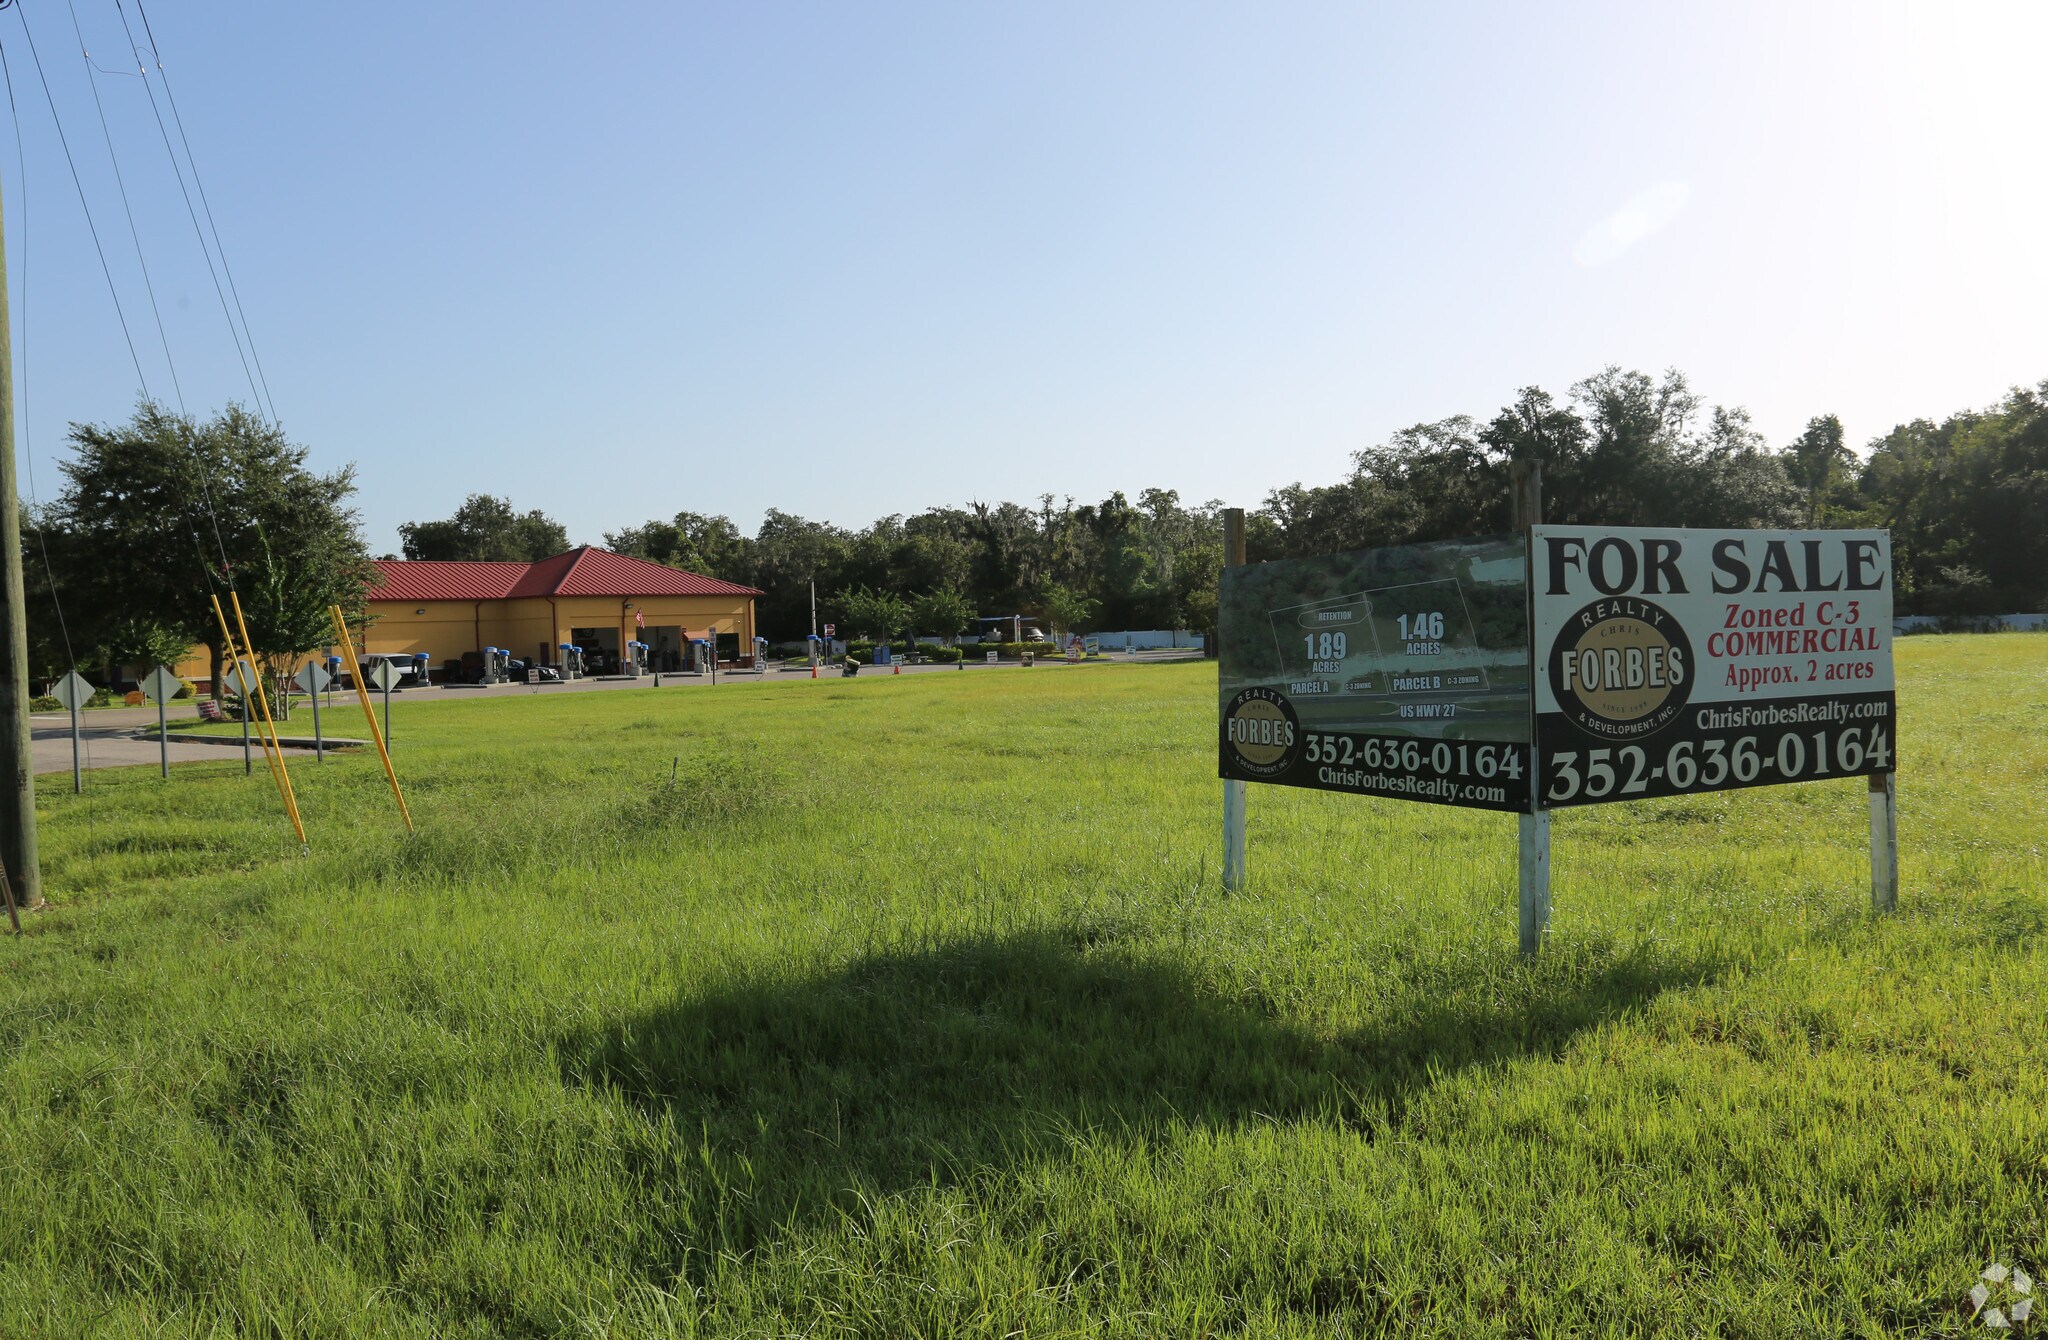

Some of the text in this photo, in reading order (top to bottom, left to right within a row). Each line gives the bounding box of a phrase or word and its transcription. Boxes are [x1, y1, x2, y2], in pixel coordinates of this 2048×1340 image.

[1543, 536, 1885, 596] FOR SALE
[1318, 611, 1352, 621] RETENTION
[1397, 611, 1444, 640] 1.46
[1581, 600, 1664, 628] REALTY
[1723, 600, 1860, 629] Zoned C-3
[1304, 632, 1347, 660] 1.89
[1600, 625, 1640, 638] CHRIS
[1707, 627, 1881, 658] COMMERCIAL
[1406, 642, 1441, 655] ACRES
[1312, 661, 1340, 673] ACRES
[1447, 675, 1480, 685] C-3 ZONING
[1561, 646, 1684, 691] FORBES
[1724, 659, 1874, 692] Approx. 2 acres
[1237, 689, 1284, 707] REALTY
[1291, 681, 1329, 694] PARCEL A
[1393, 676, 1441, 691] PARCEL B
[1400, 704, 1456, 718] US HWY 27
[1579, 705, 1676, 735] & DEVELOPMENT, INC.
[1697, 700, 1888, 730] ChrisForbesRealty.com
[1227, 717, 1294, 747] FORBES
[1305, 734, 1524, 780] 352-636-0164
[1548, 723, 1891, 801] 352-636-0164
[1318, 766, 1506, 802] ChrisForbesRealty.com
